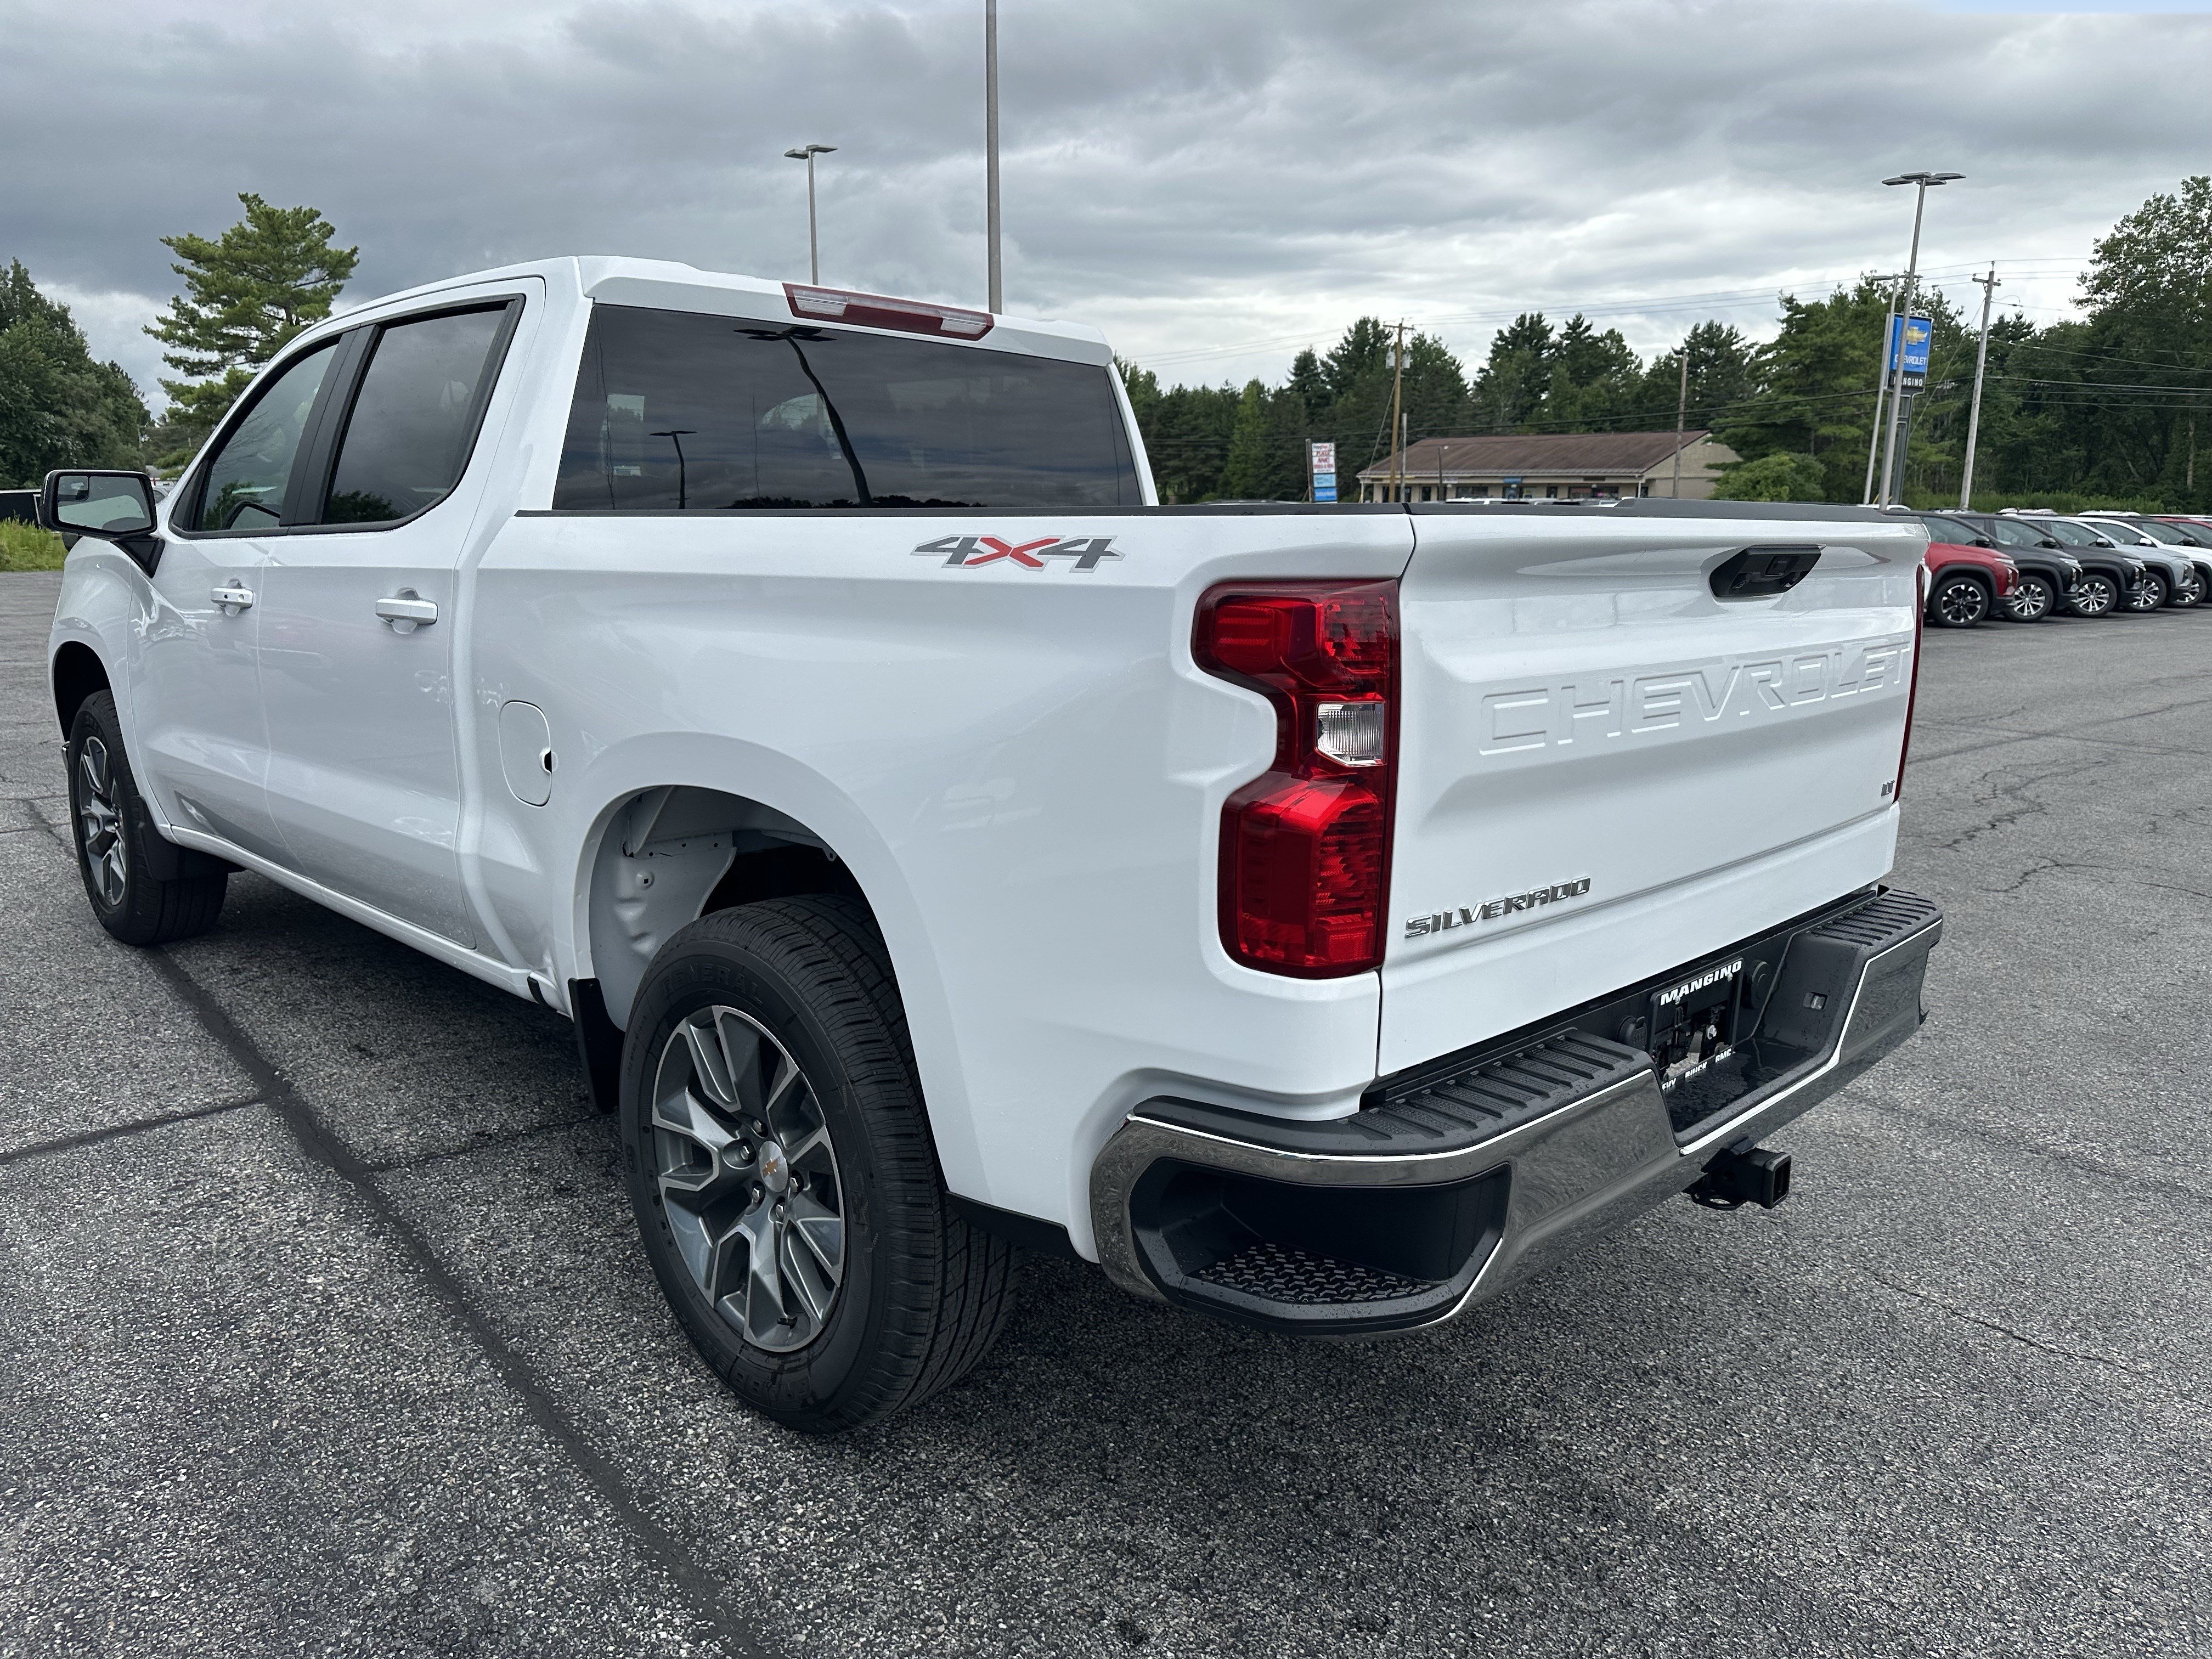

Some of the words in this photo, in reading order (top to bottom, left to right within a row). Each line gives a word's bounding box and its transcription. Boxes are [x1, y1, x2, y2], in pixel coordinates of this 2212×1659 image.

[1894, 354, 1927, 365] CEVROLET
[1893, 376, 1923, 386] NGINO
[913, 535, 1121, 571] 4X4
[1479, 641, 1911, 755] CHEVROLET
[1881, 780, 1895, 797] LT
[1403, 876, 1592, 938] SILVERADO
[1660, 961, 1742, 1006] MANGINO
[1715, 1047, 1732, 1063] GMC
